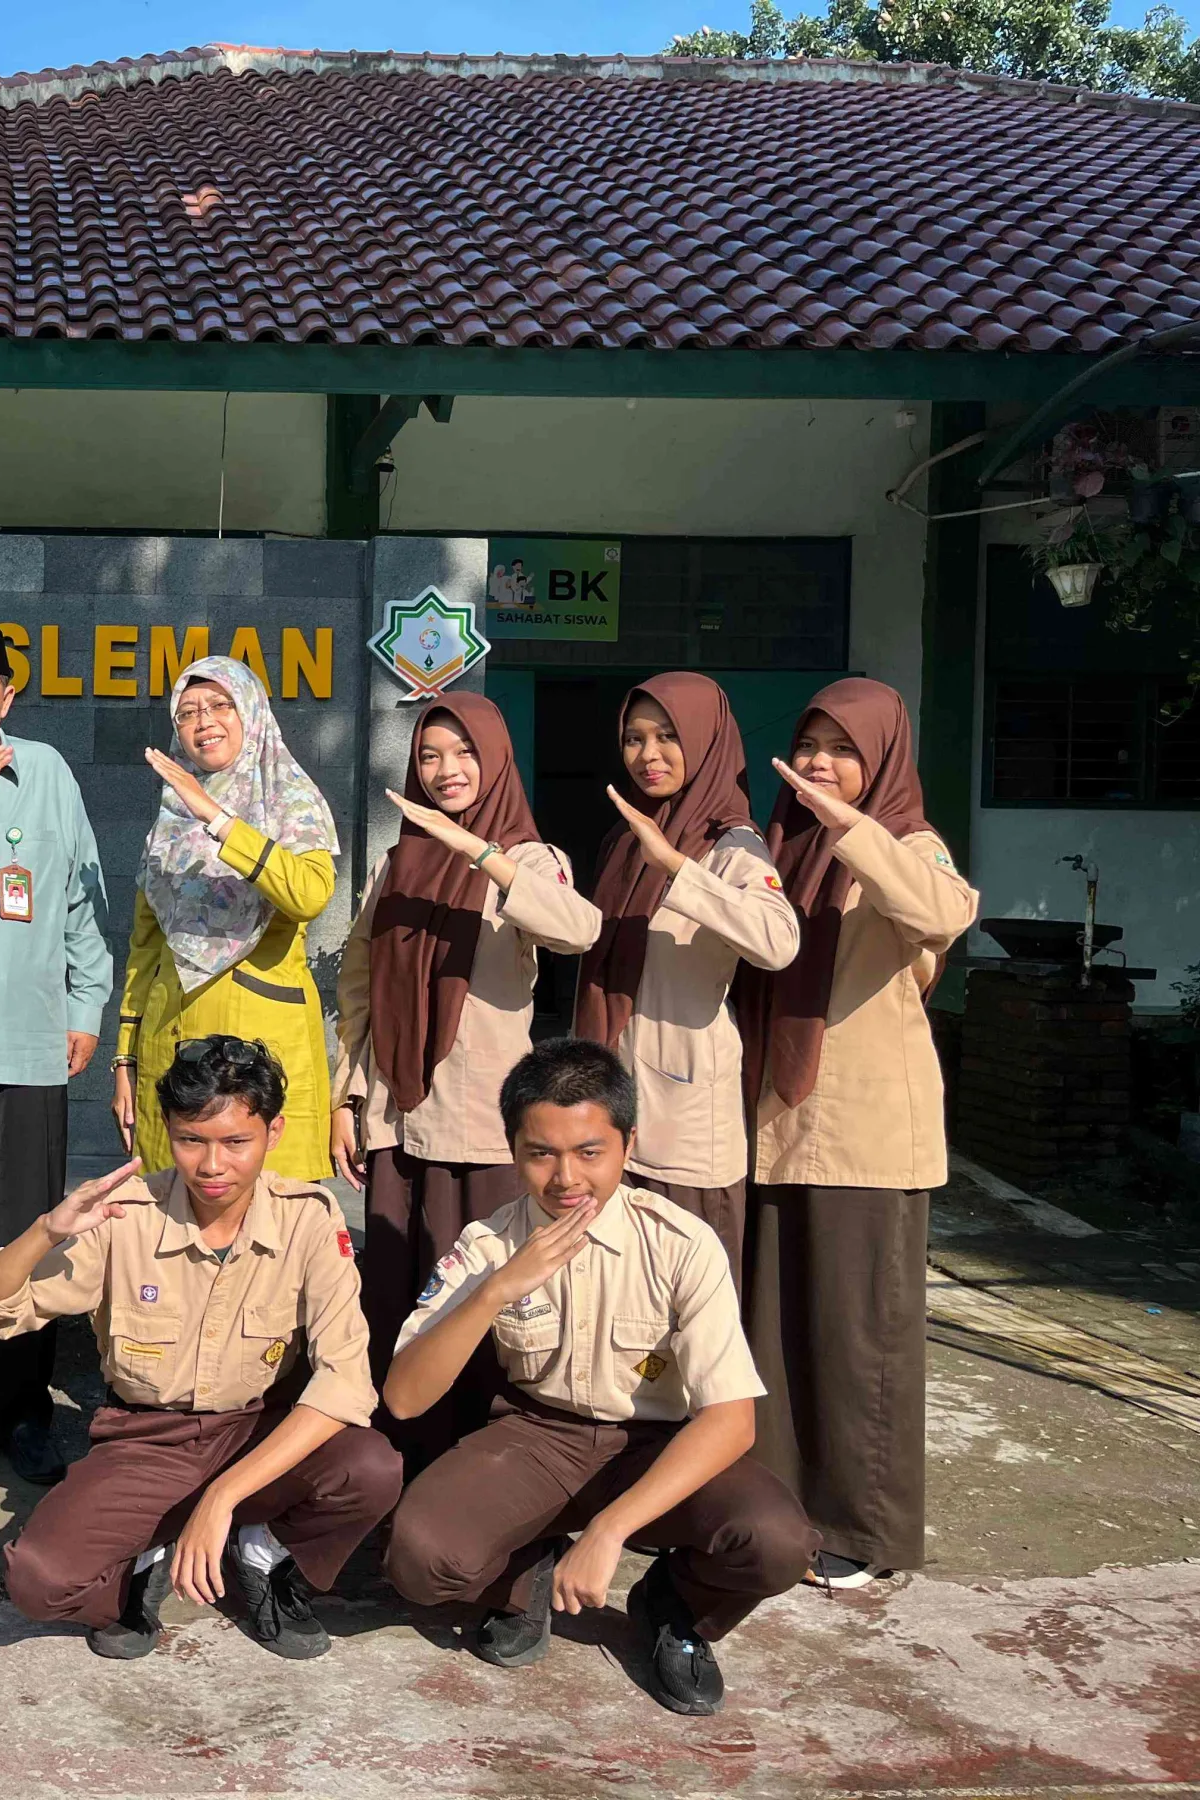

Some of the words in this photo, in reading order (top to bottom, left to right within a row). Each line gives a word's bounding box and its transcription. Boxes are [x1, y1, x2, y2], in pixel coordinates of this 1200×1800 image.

[547, 569, 609, 603] BK
[496, 612, 561, 625] SAHABAT
[563, 613, 608, 626] SISWA
